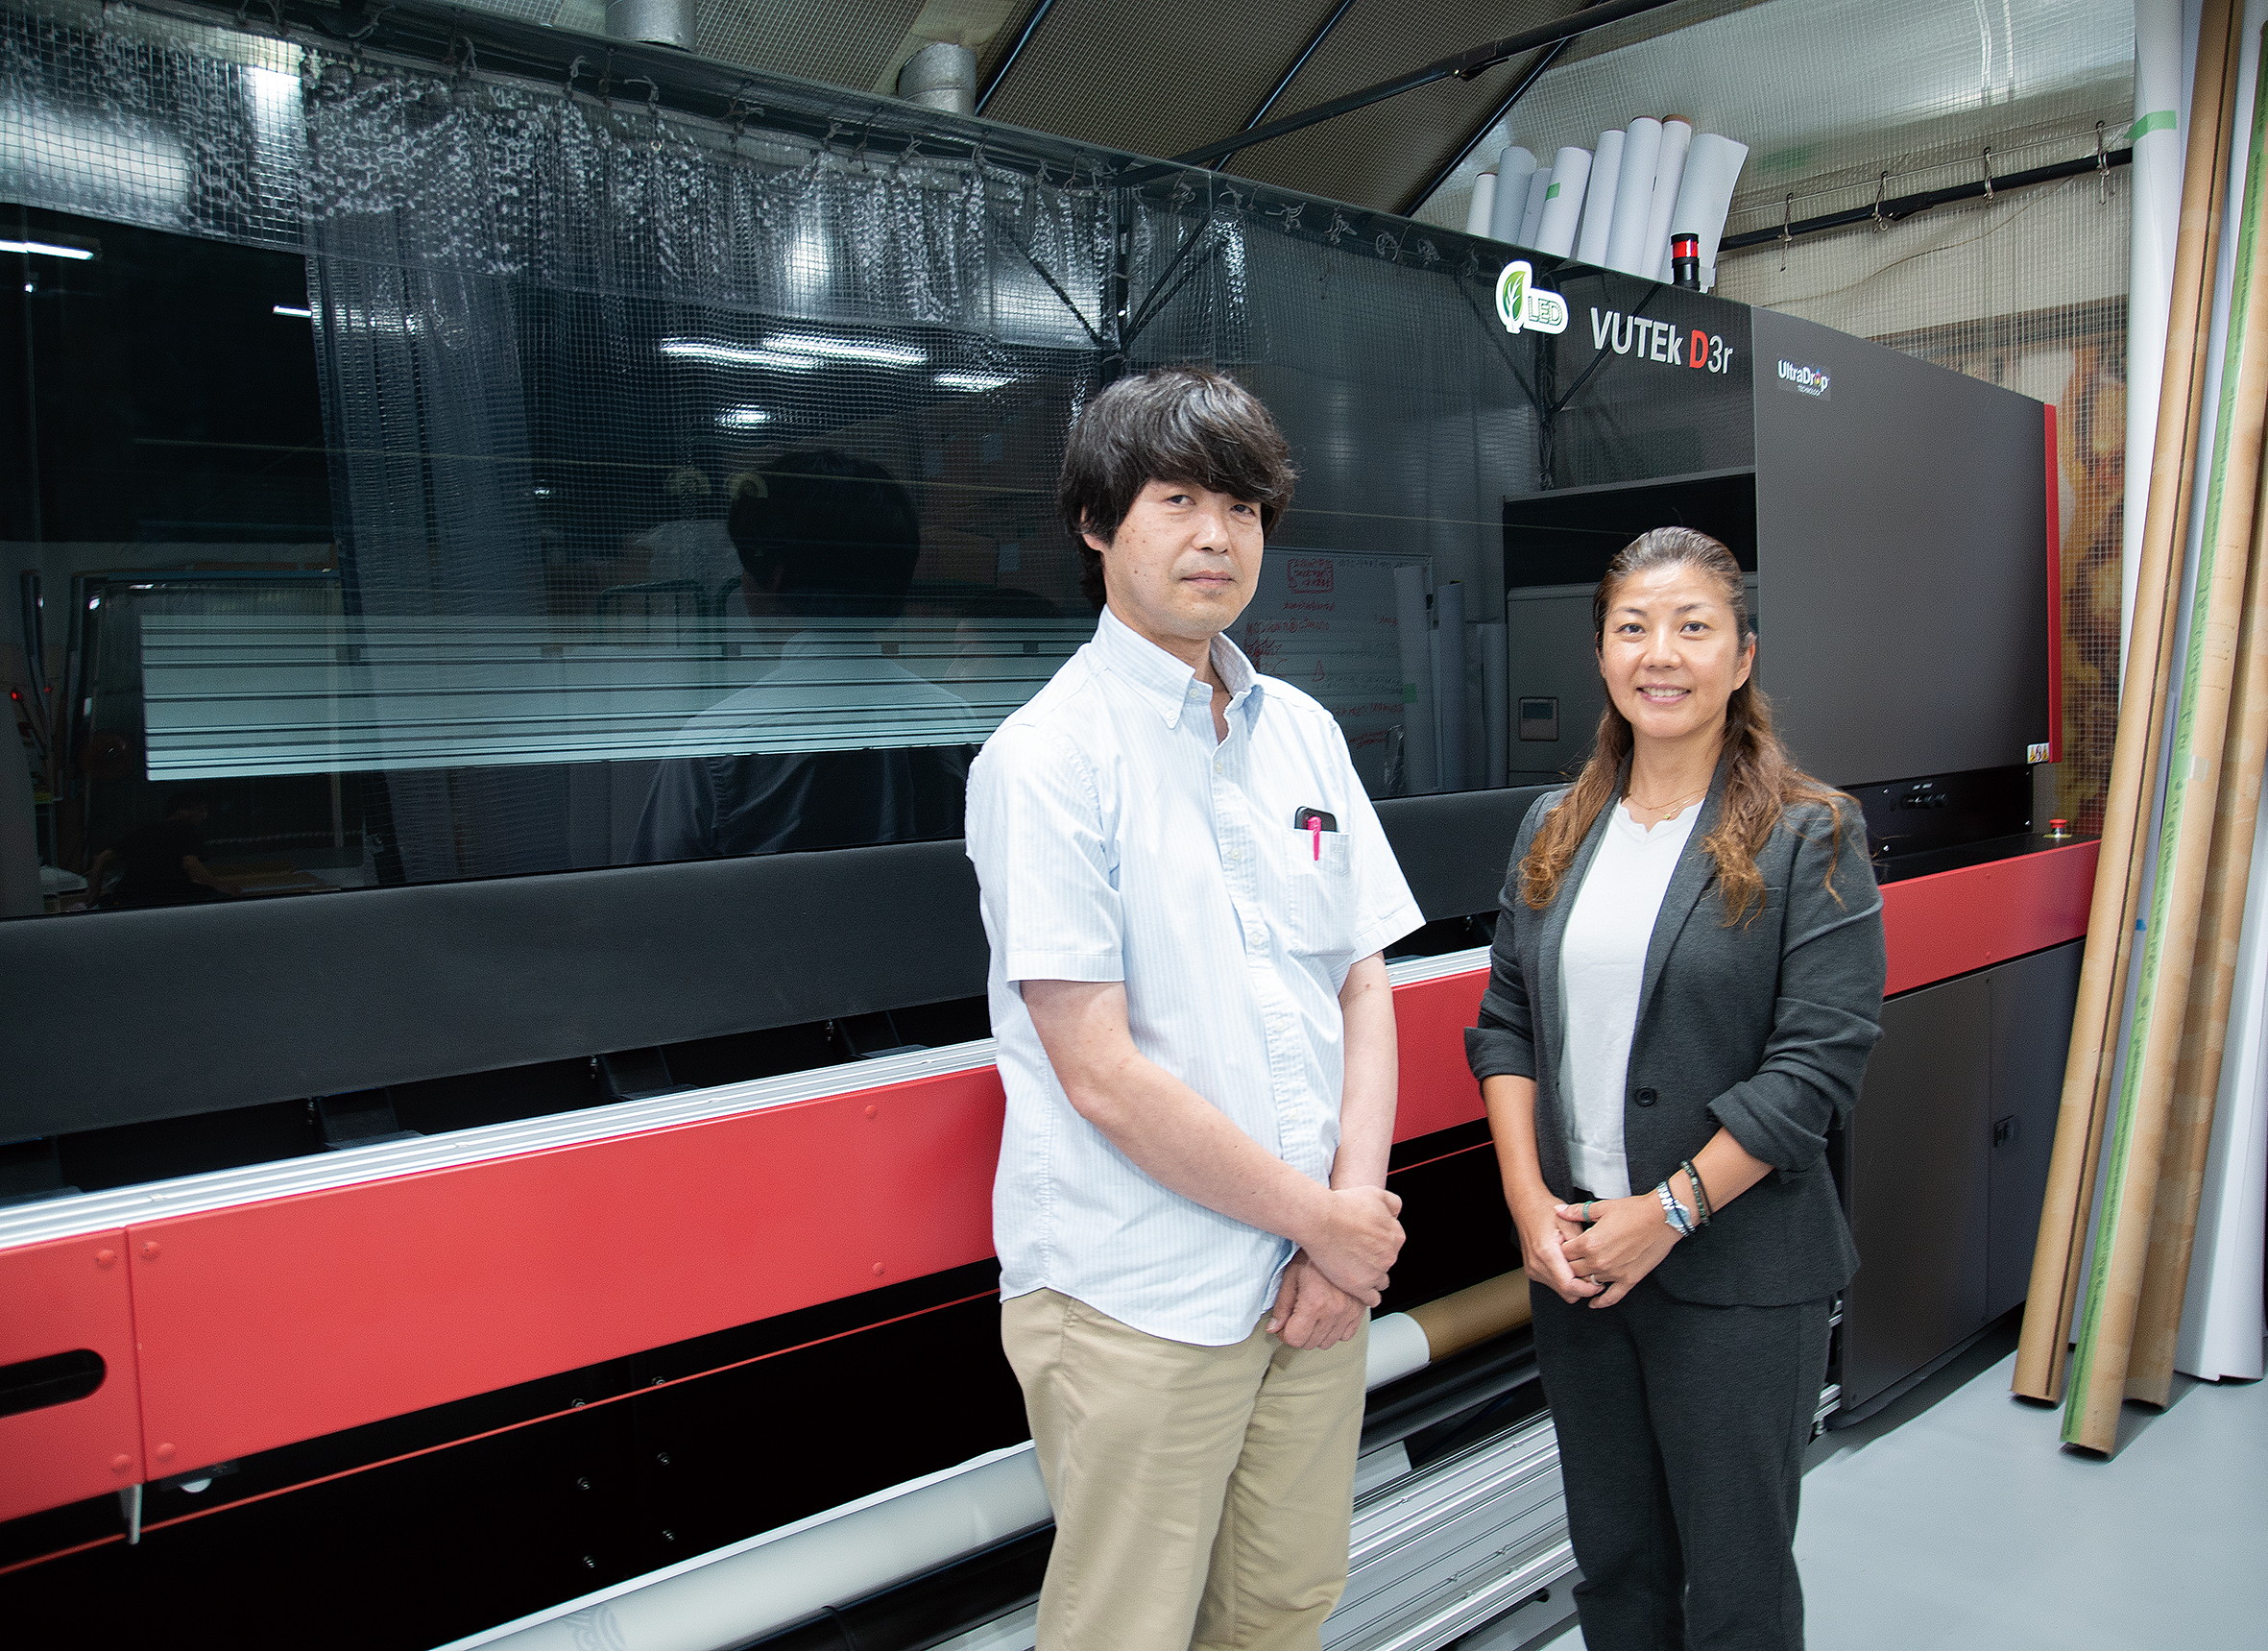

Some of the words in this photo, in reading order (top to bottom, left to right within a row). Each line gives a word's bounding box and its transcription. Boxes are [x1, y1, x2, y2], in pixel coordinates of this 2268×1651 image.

[1528, 296, 1563, 327] LED
[1590, 307, 1684, 366] VUTEk
[1689, 328, 1734, 375] D3r
[1777, 359, 1828, 393] UltraDrop
